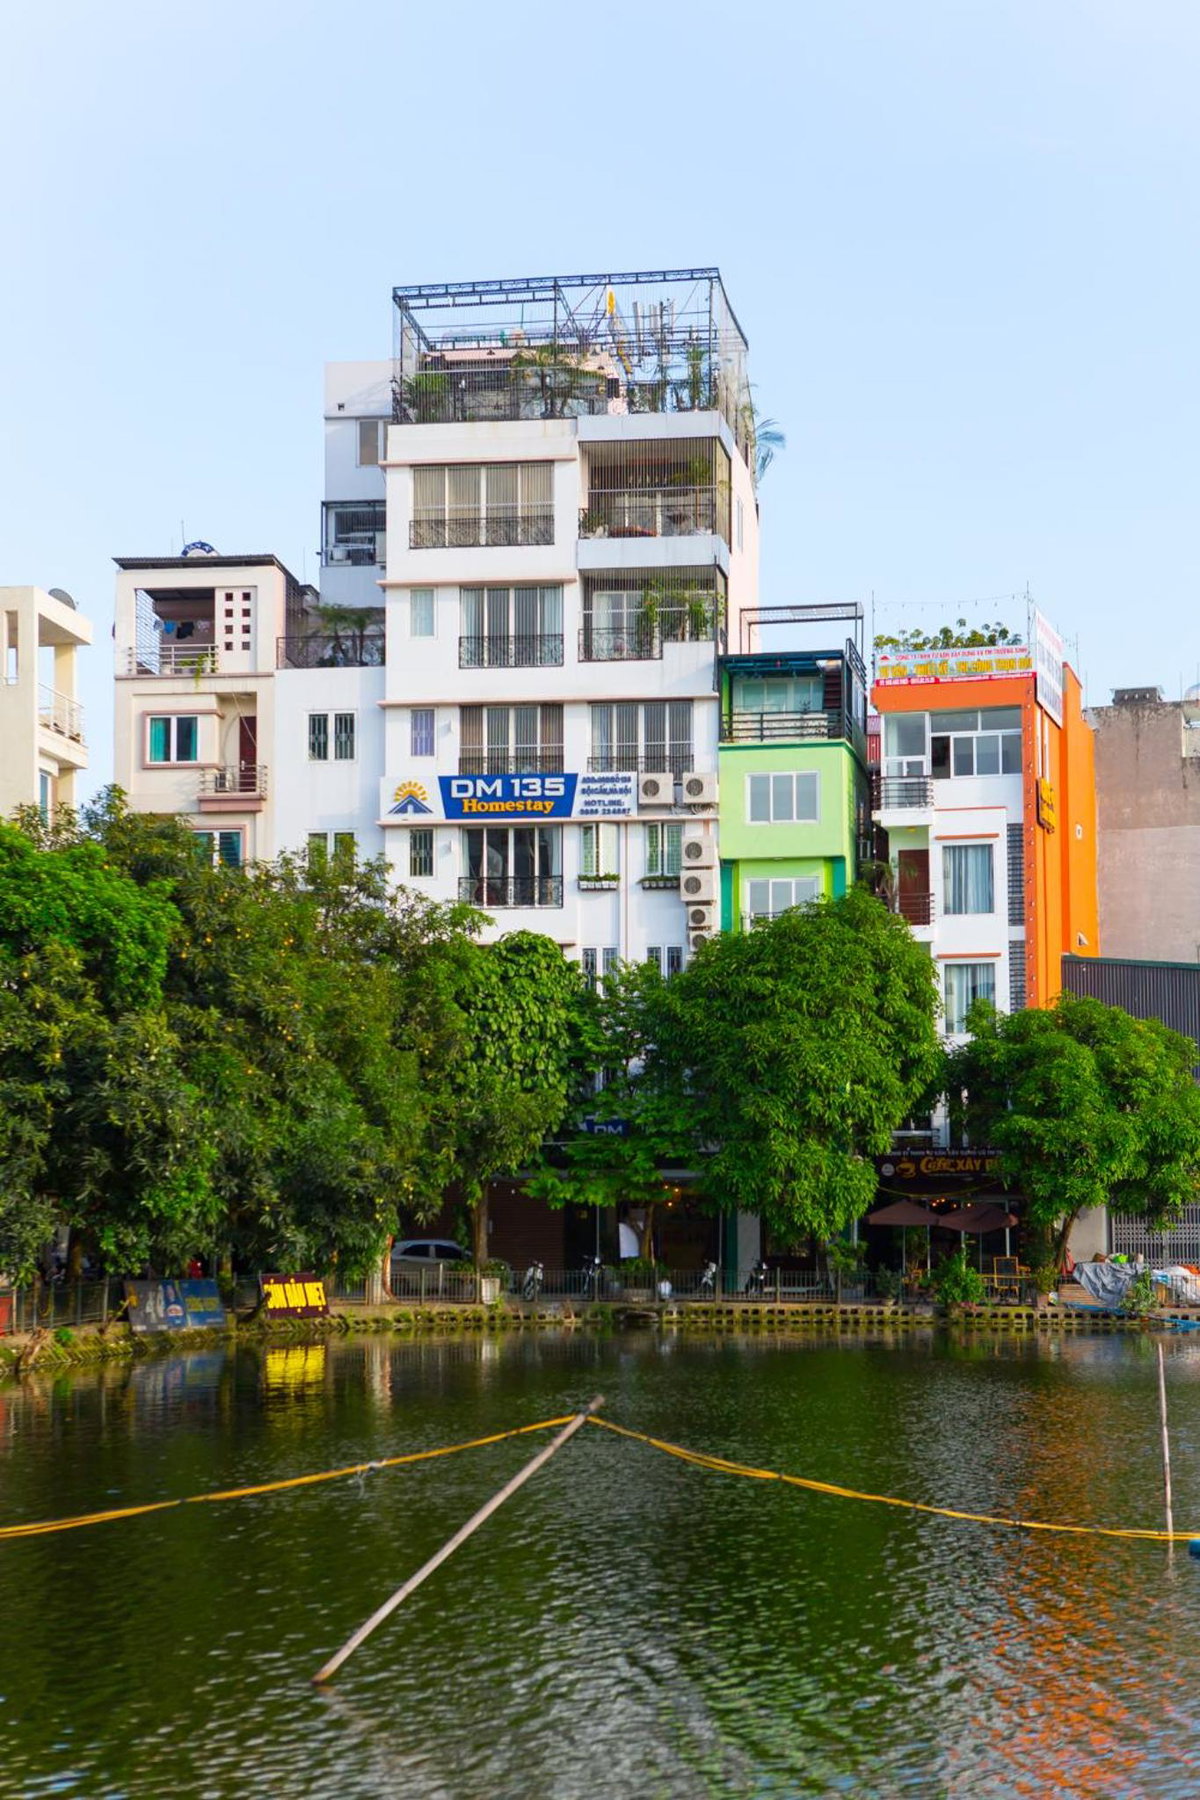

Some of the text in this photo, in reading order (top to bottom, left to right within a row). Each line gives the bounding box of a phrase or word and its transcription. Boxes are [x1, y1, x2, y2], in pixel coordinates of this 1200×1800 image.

[451, 777, 566, 799] DM 135
[462, 798, 555, 814] Homestay
